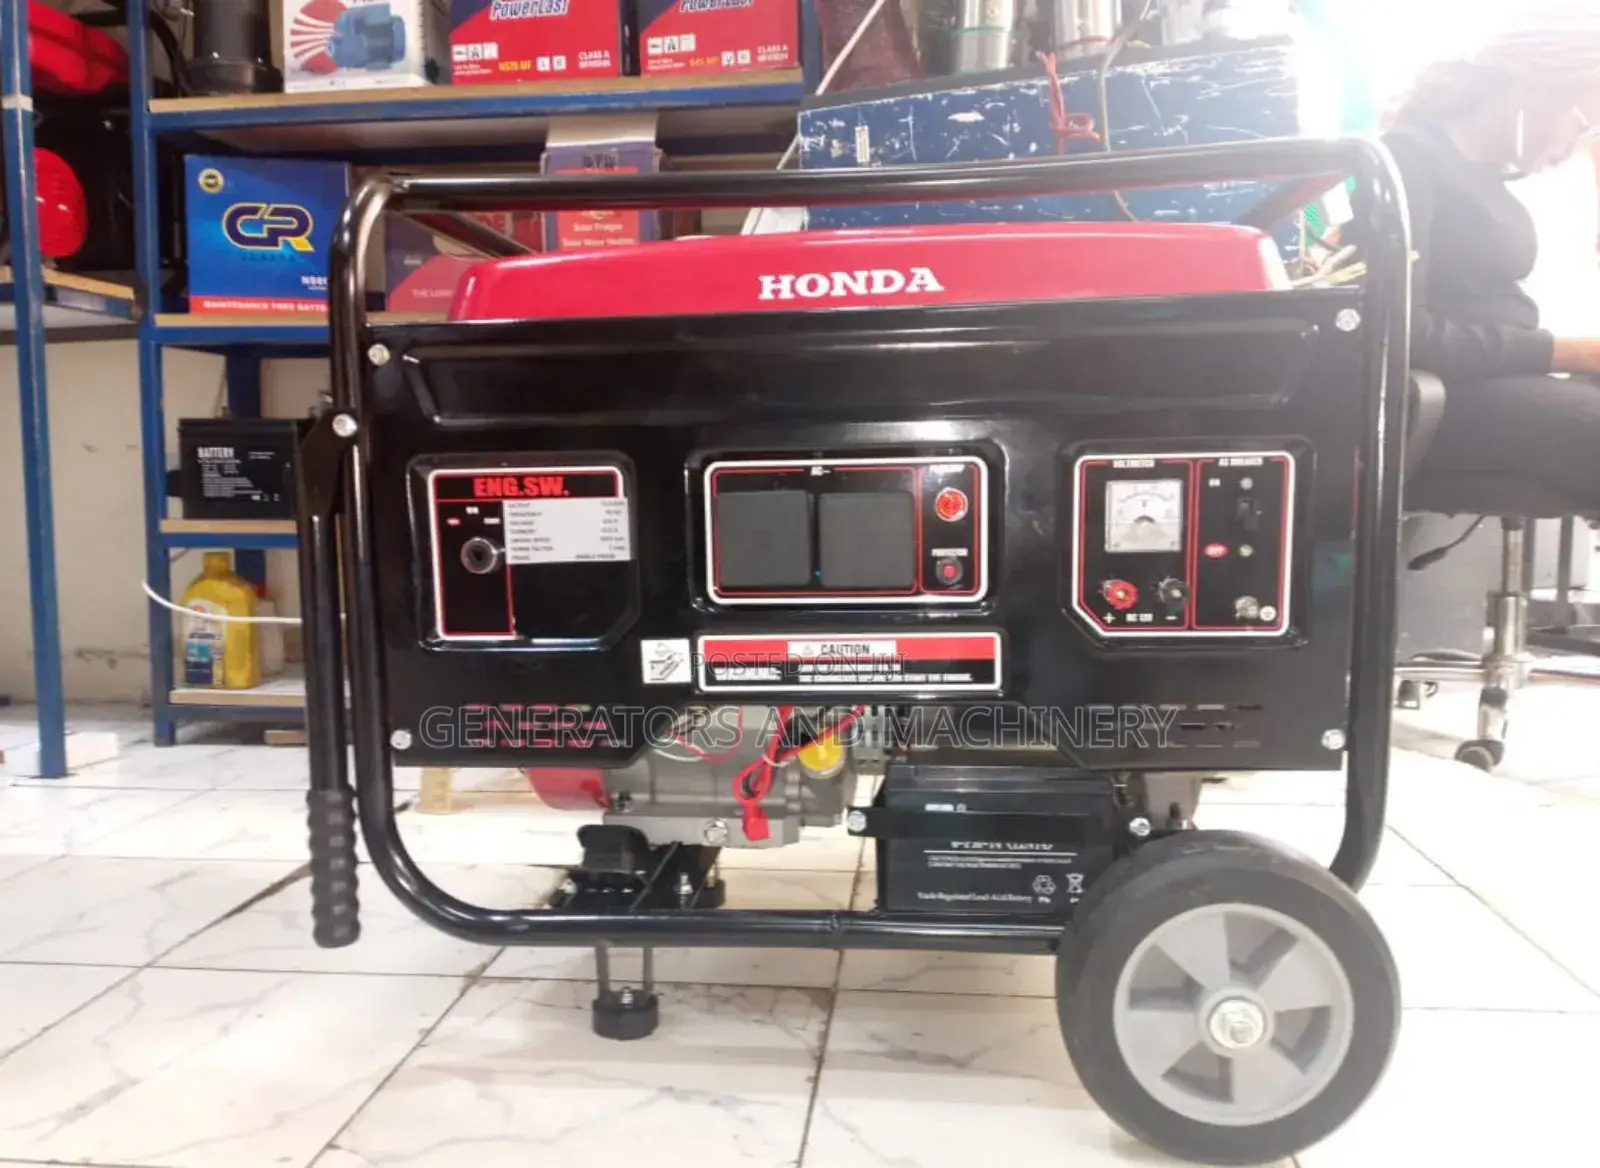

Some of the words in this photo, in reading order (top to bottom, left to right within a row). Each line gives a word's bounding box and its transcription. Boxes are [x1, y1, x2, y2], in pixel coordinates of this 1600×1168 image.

[758, 267, 945, 300] HONDA
[197, 447, 235, 458] BATTERY
[821, 644, 870, 654] CAUTION
